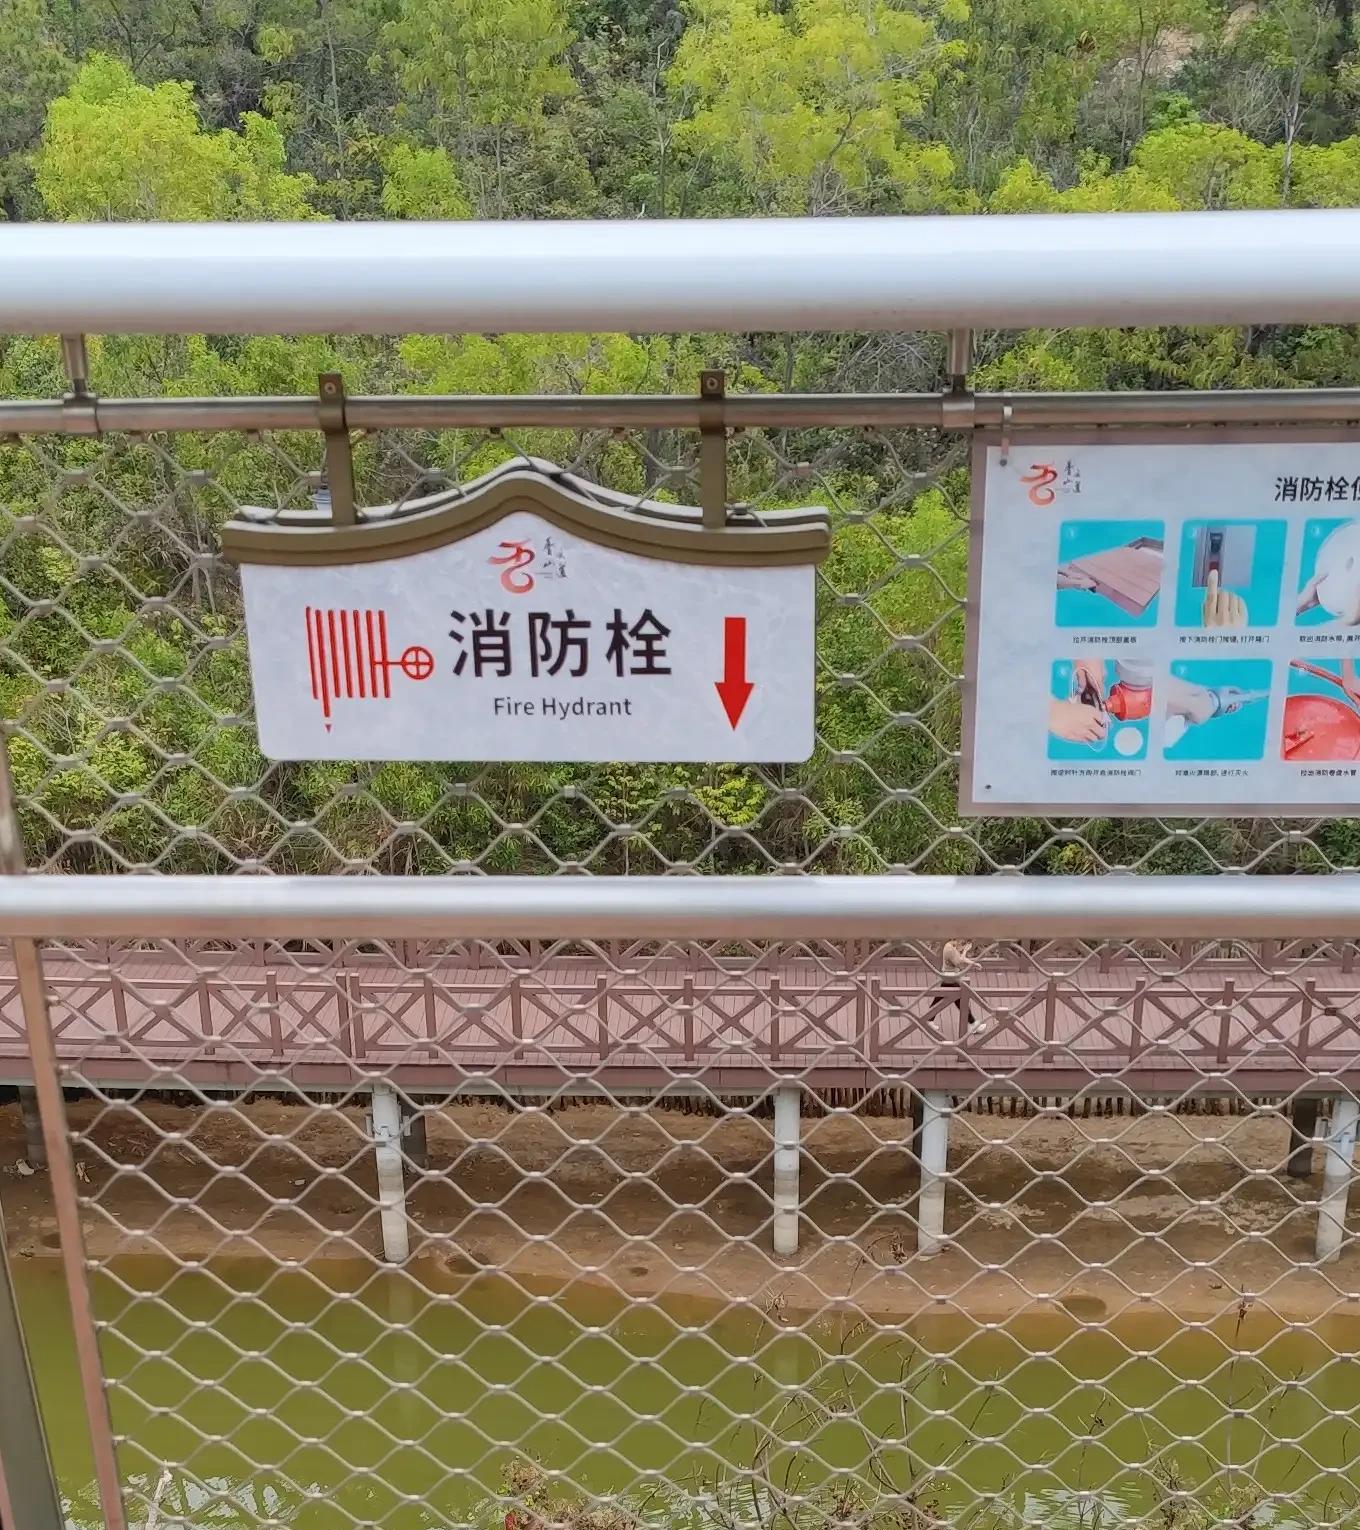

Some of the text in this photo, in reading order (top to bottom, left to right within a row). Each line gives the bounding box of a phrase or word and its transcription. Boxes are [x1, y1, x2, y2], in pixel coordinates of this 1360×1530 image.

[447, 607, 673, 679] 消防栓
[494, 696, 633, 721] Fire Hydrant
